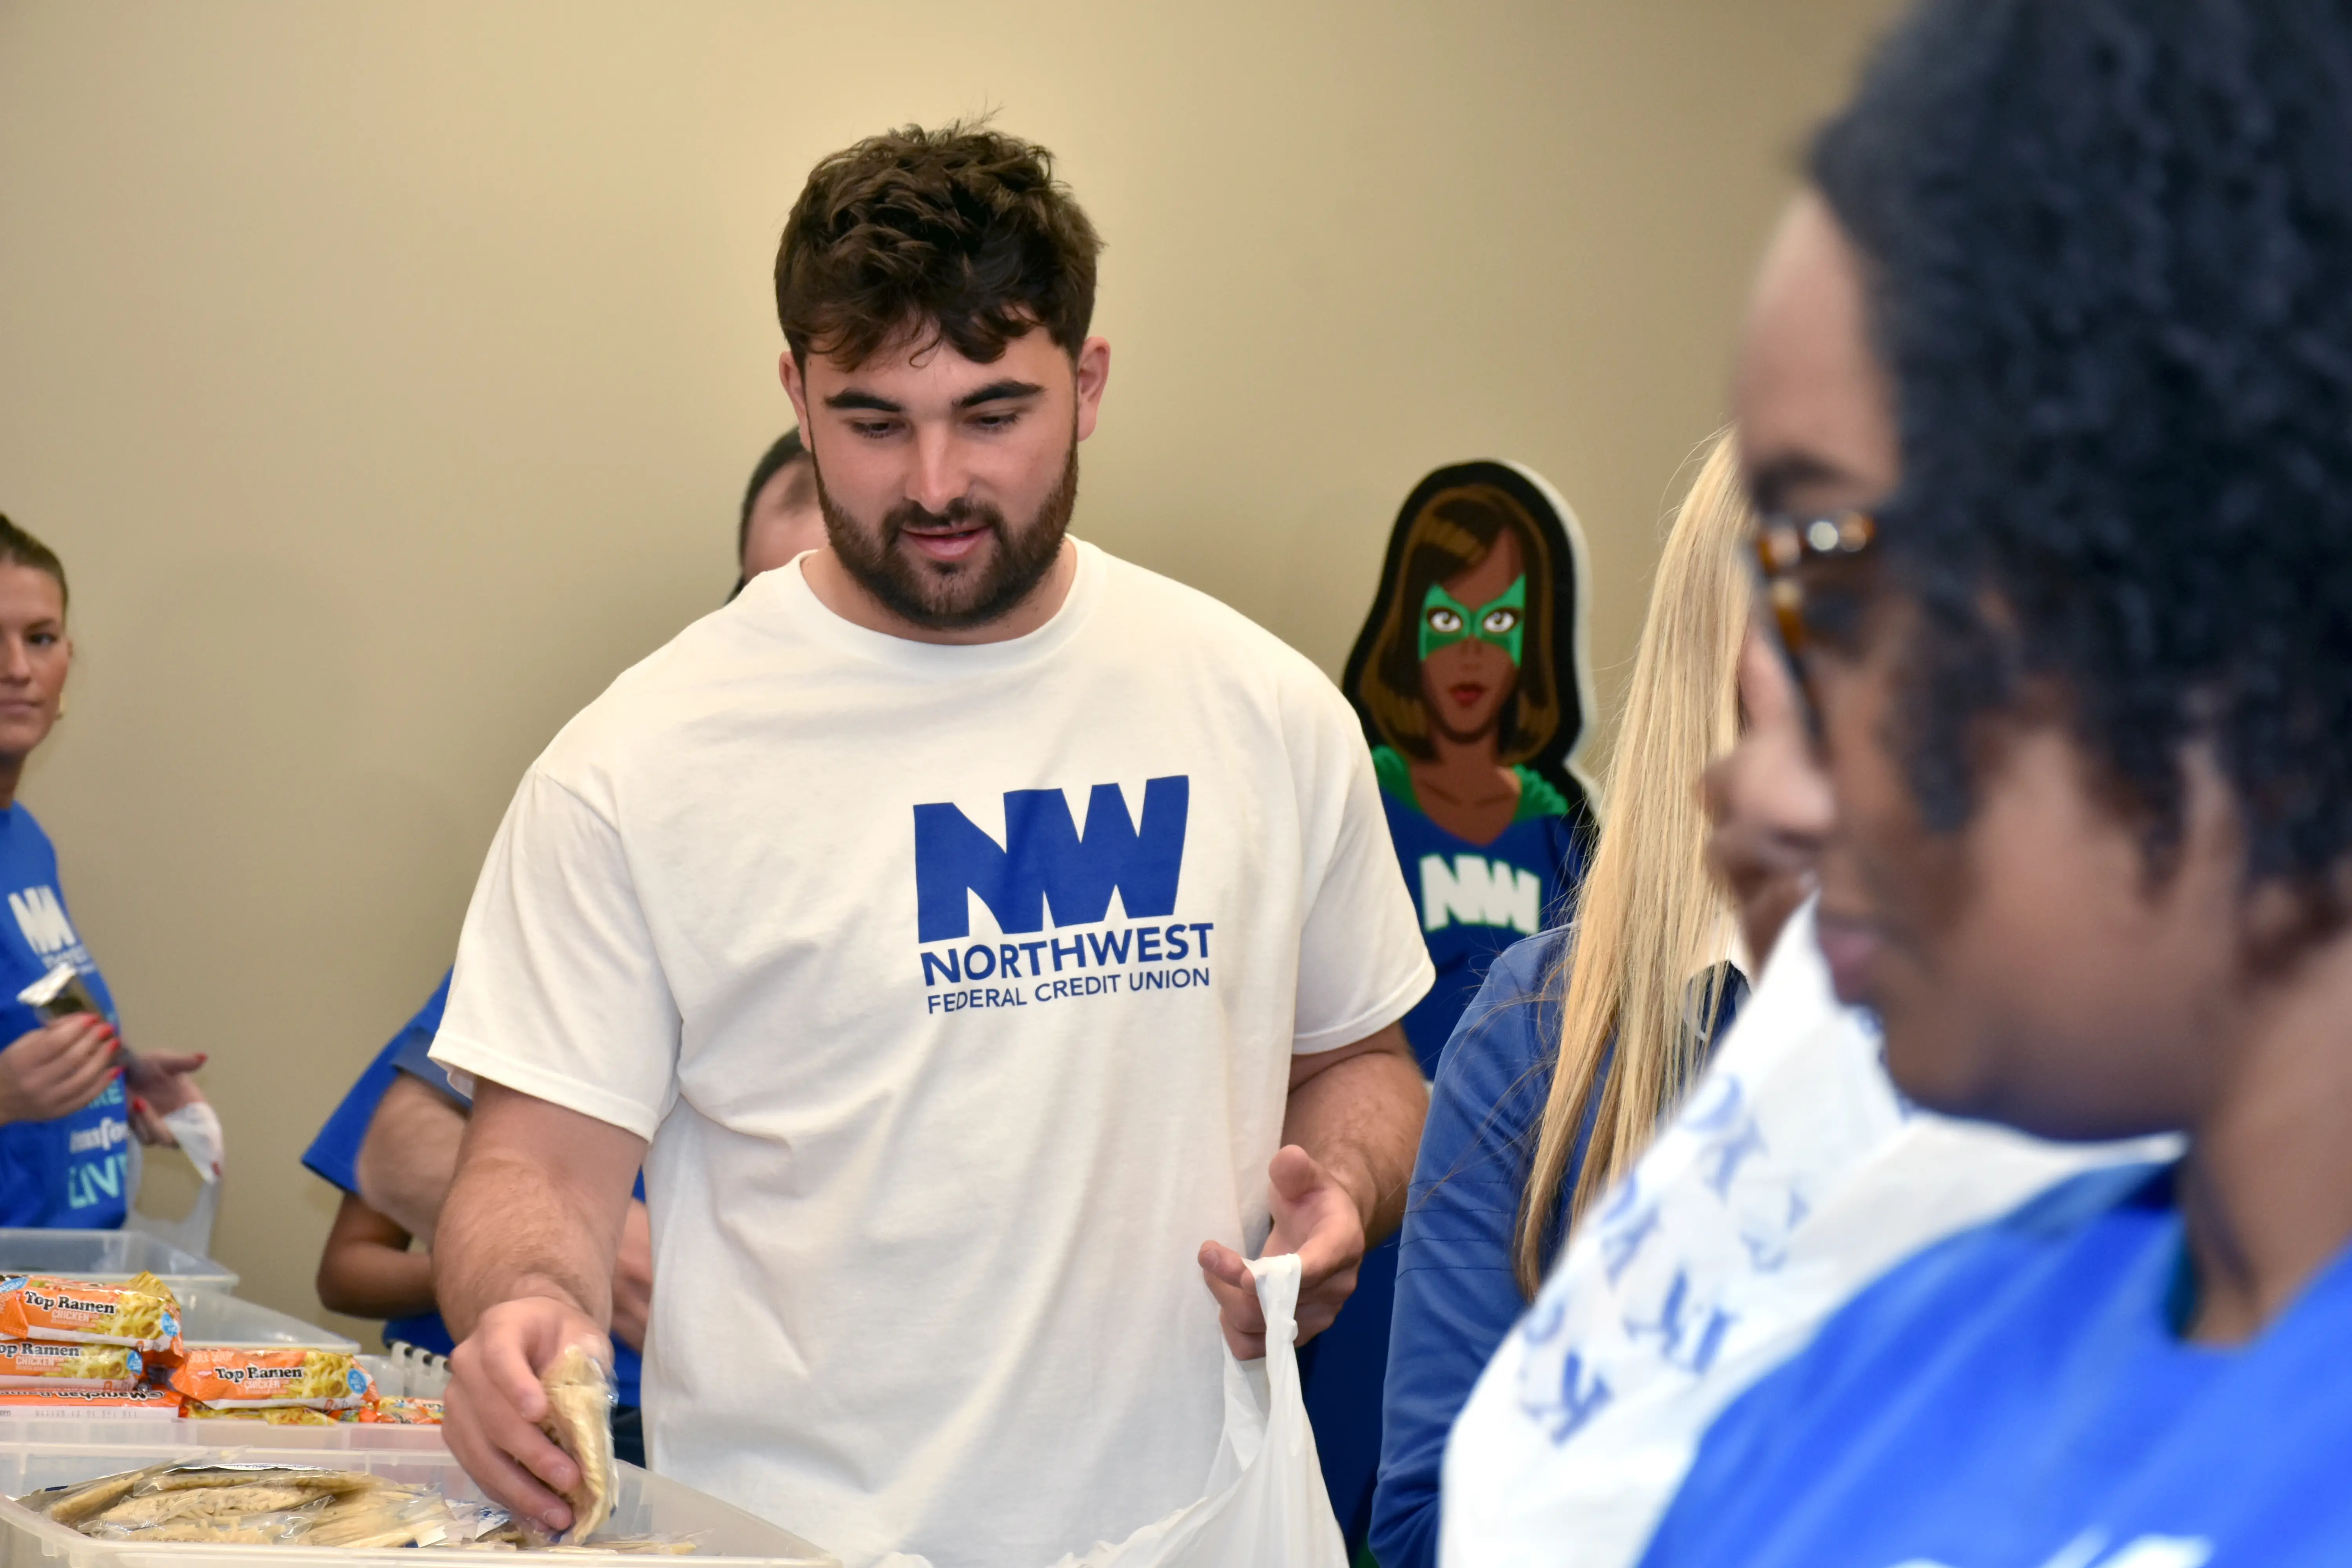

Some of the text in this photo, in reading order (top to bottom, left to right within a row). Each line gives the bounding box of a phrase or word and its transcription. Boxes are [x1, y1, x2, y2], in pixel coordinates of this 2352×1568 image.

[913, 775, 1189, 944] NW
[1419, 853, 1541, 934] NW
[920, 922, 1214, 986] NORTHWEST
[927, 968, 1210, 1014] FEDERAL CREDIT UNION
[25, 1290, 54, 1310] Top
[57, 1296, 115, 1314] Ramen
[51, 1309, 90, 1322] CHICKEN
[0, 1343, 80, 1357] op Ramen
[16, 1356, 55, 1366] CHICKEN
[215, 1367, 302, 1383] Top Ramen
[244, 1379, 280, 1390] CHICKEN
